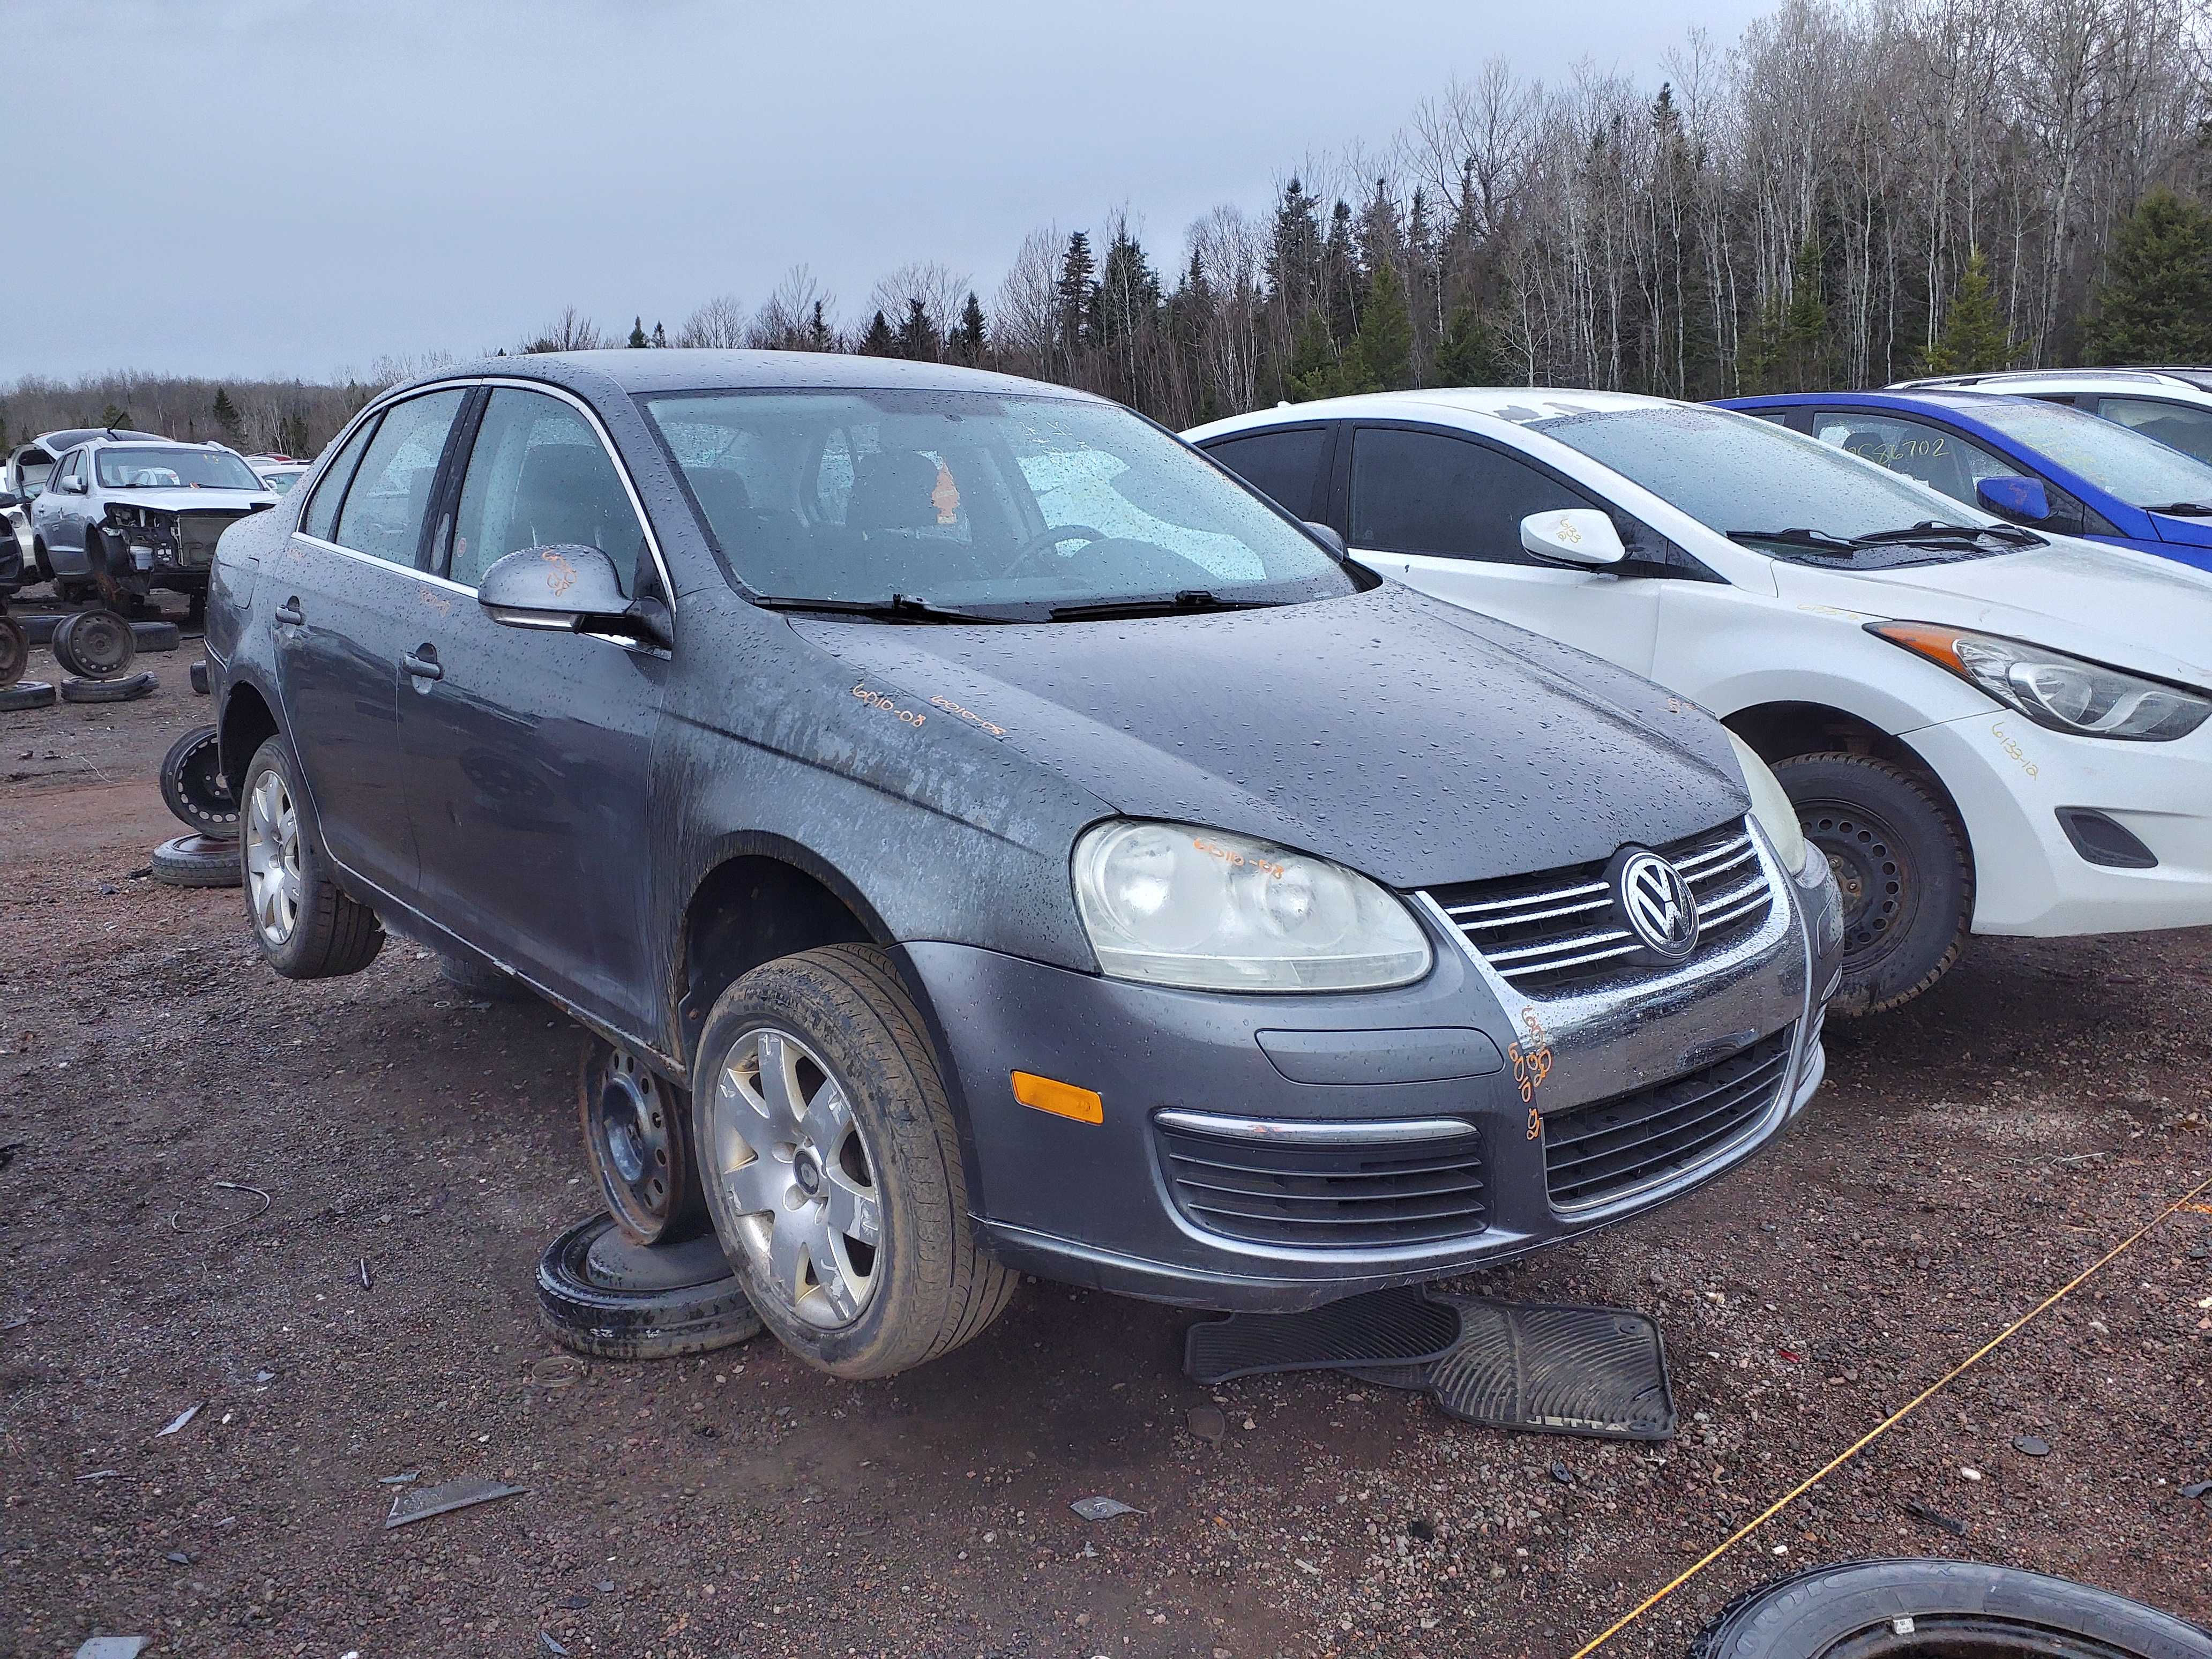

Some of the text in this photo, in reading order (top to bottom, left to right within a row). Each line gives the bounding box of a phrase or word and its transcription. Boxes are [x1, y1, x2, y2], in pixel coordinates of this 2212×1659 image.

[853, 683, 926, 728] 6010-08
[1992, 721, 2038, 781] 6133-12
[1627, 856, 1693, 949] VW
[1526, 1415, 1627, 1432] JETTA
[1728, 1572, 1855, 1659] ORDIC
